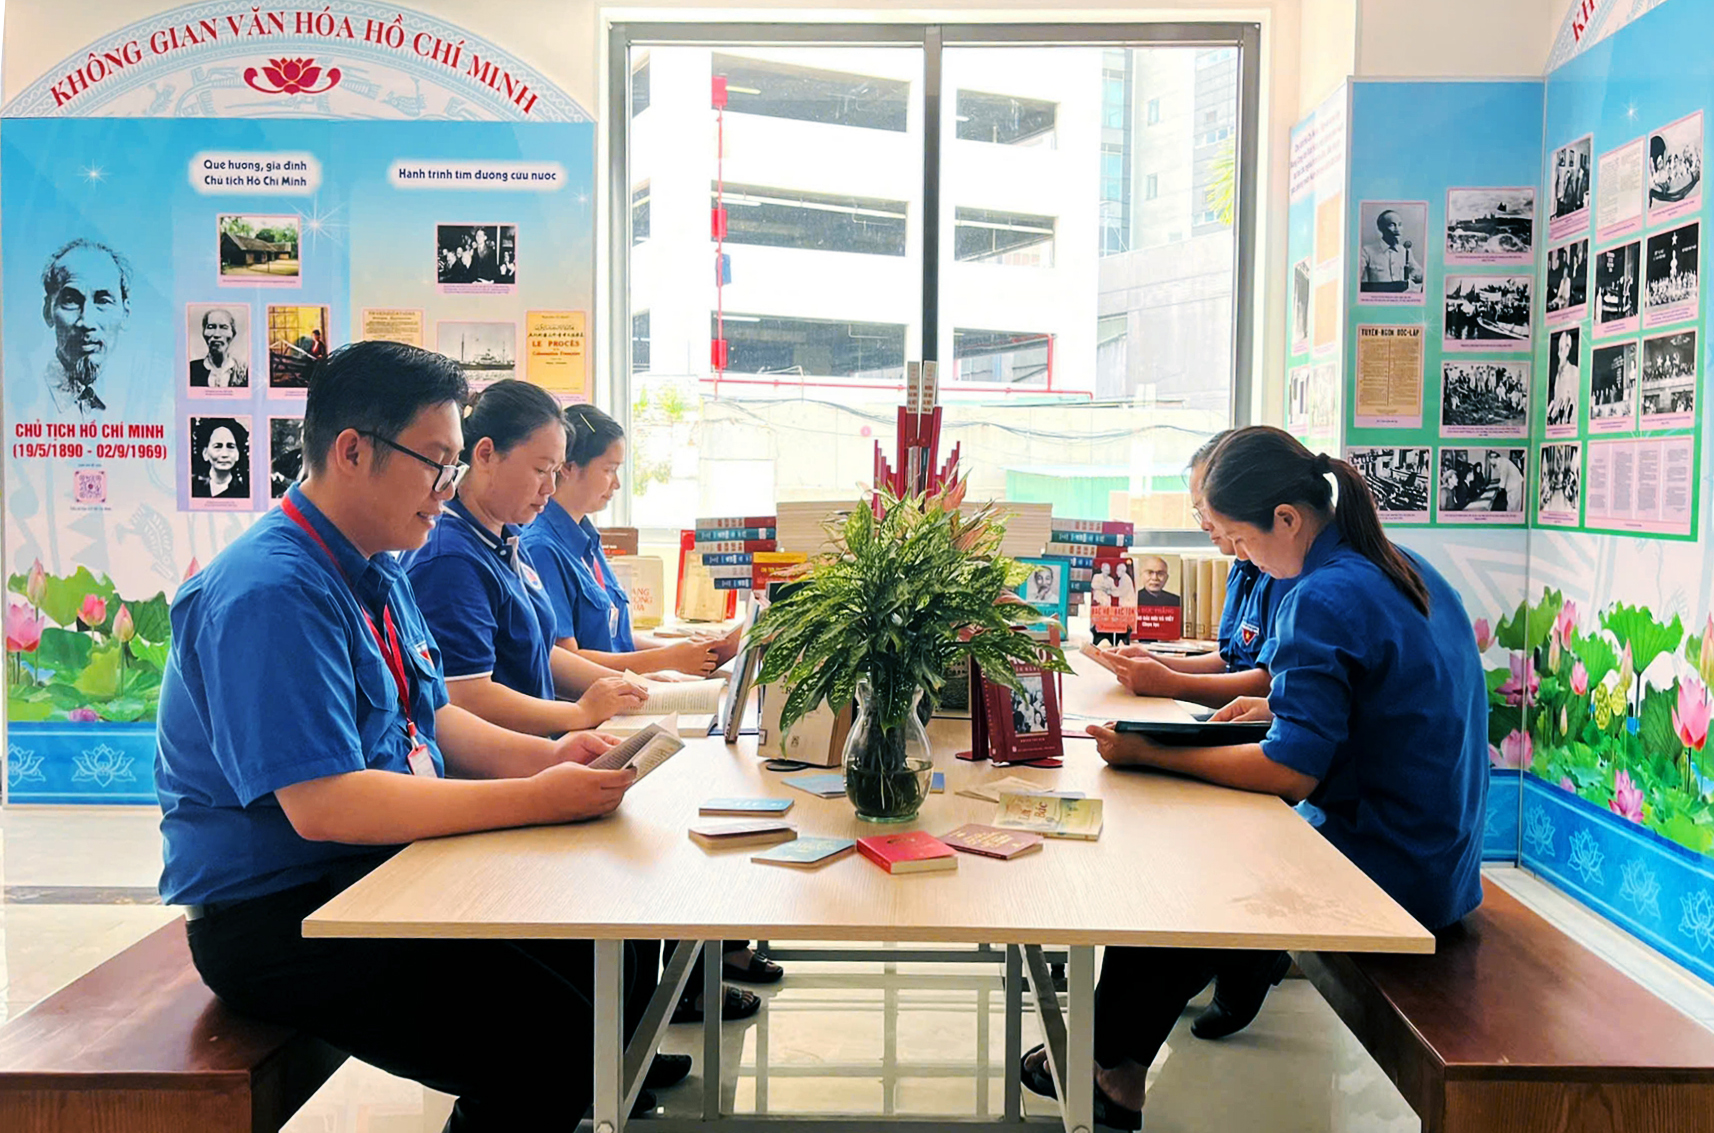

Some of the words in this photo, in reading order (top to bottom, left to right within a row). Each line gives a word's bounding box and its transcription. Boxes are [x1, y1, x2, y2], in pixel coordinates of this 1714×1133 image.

[50, 41, 143, 107] KHÔNG
[150, 19, 218, 55] GIAN
[226, 6, 285, 37] VĂN
[295, 6, 355, 39] HÓA
[364, 13, 405, 49] HỒ
[413, 32, 466, 69] CHÍ
[466, 55, 539, 115] MINH
[281, 176, 307, 186] Minh
[15, 419, 43, 438] CHỦ
[46, 423, 76, 441] TỊCH
[101, 421, 124, 439] CHÍ
[128, 424, 165, 439] MINH
[12, 443, 84, 459] (19/5/1890
[96, 444, 168, 460] 02/9/1969)
